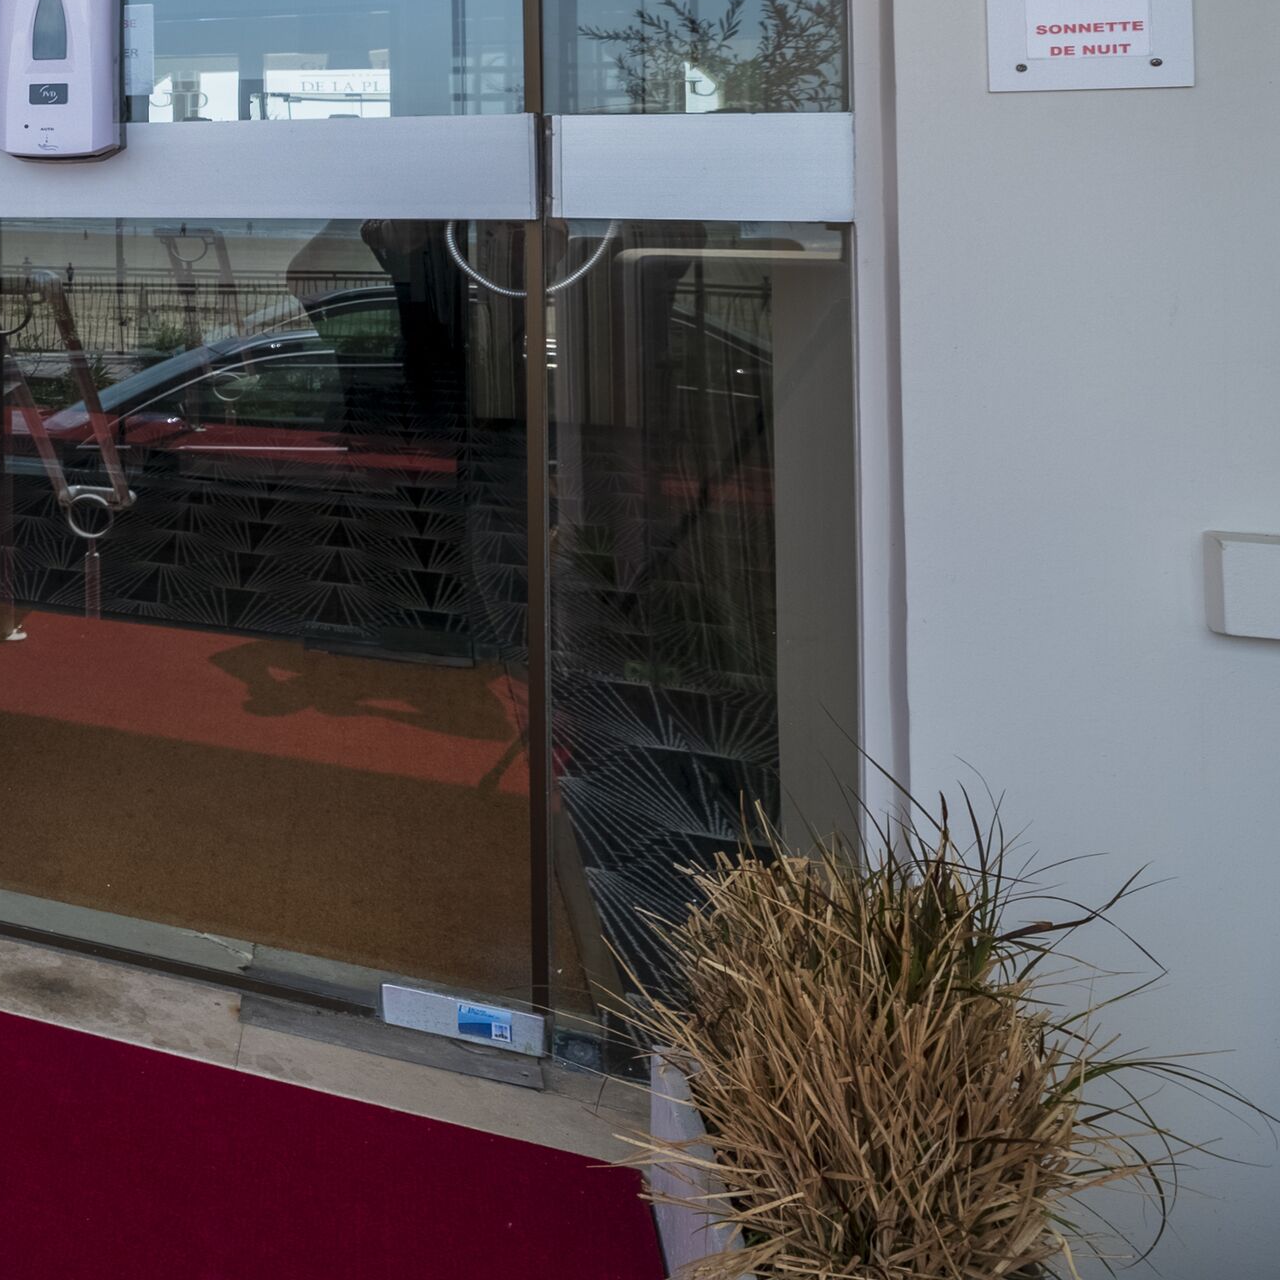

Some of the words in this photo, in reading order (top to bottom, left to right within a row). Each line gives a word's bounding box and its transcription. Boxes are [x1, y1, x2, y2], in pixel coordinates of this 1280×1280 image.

[1035, 19, 1145, 36] SONNETTE
[1049, 44, 1076, 58] DE
[1082, 42, 1132, 56] NUIT
[300, 80, 326, 93] DE
[360, 78, 389, 92] PL
